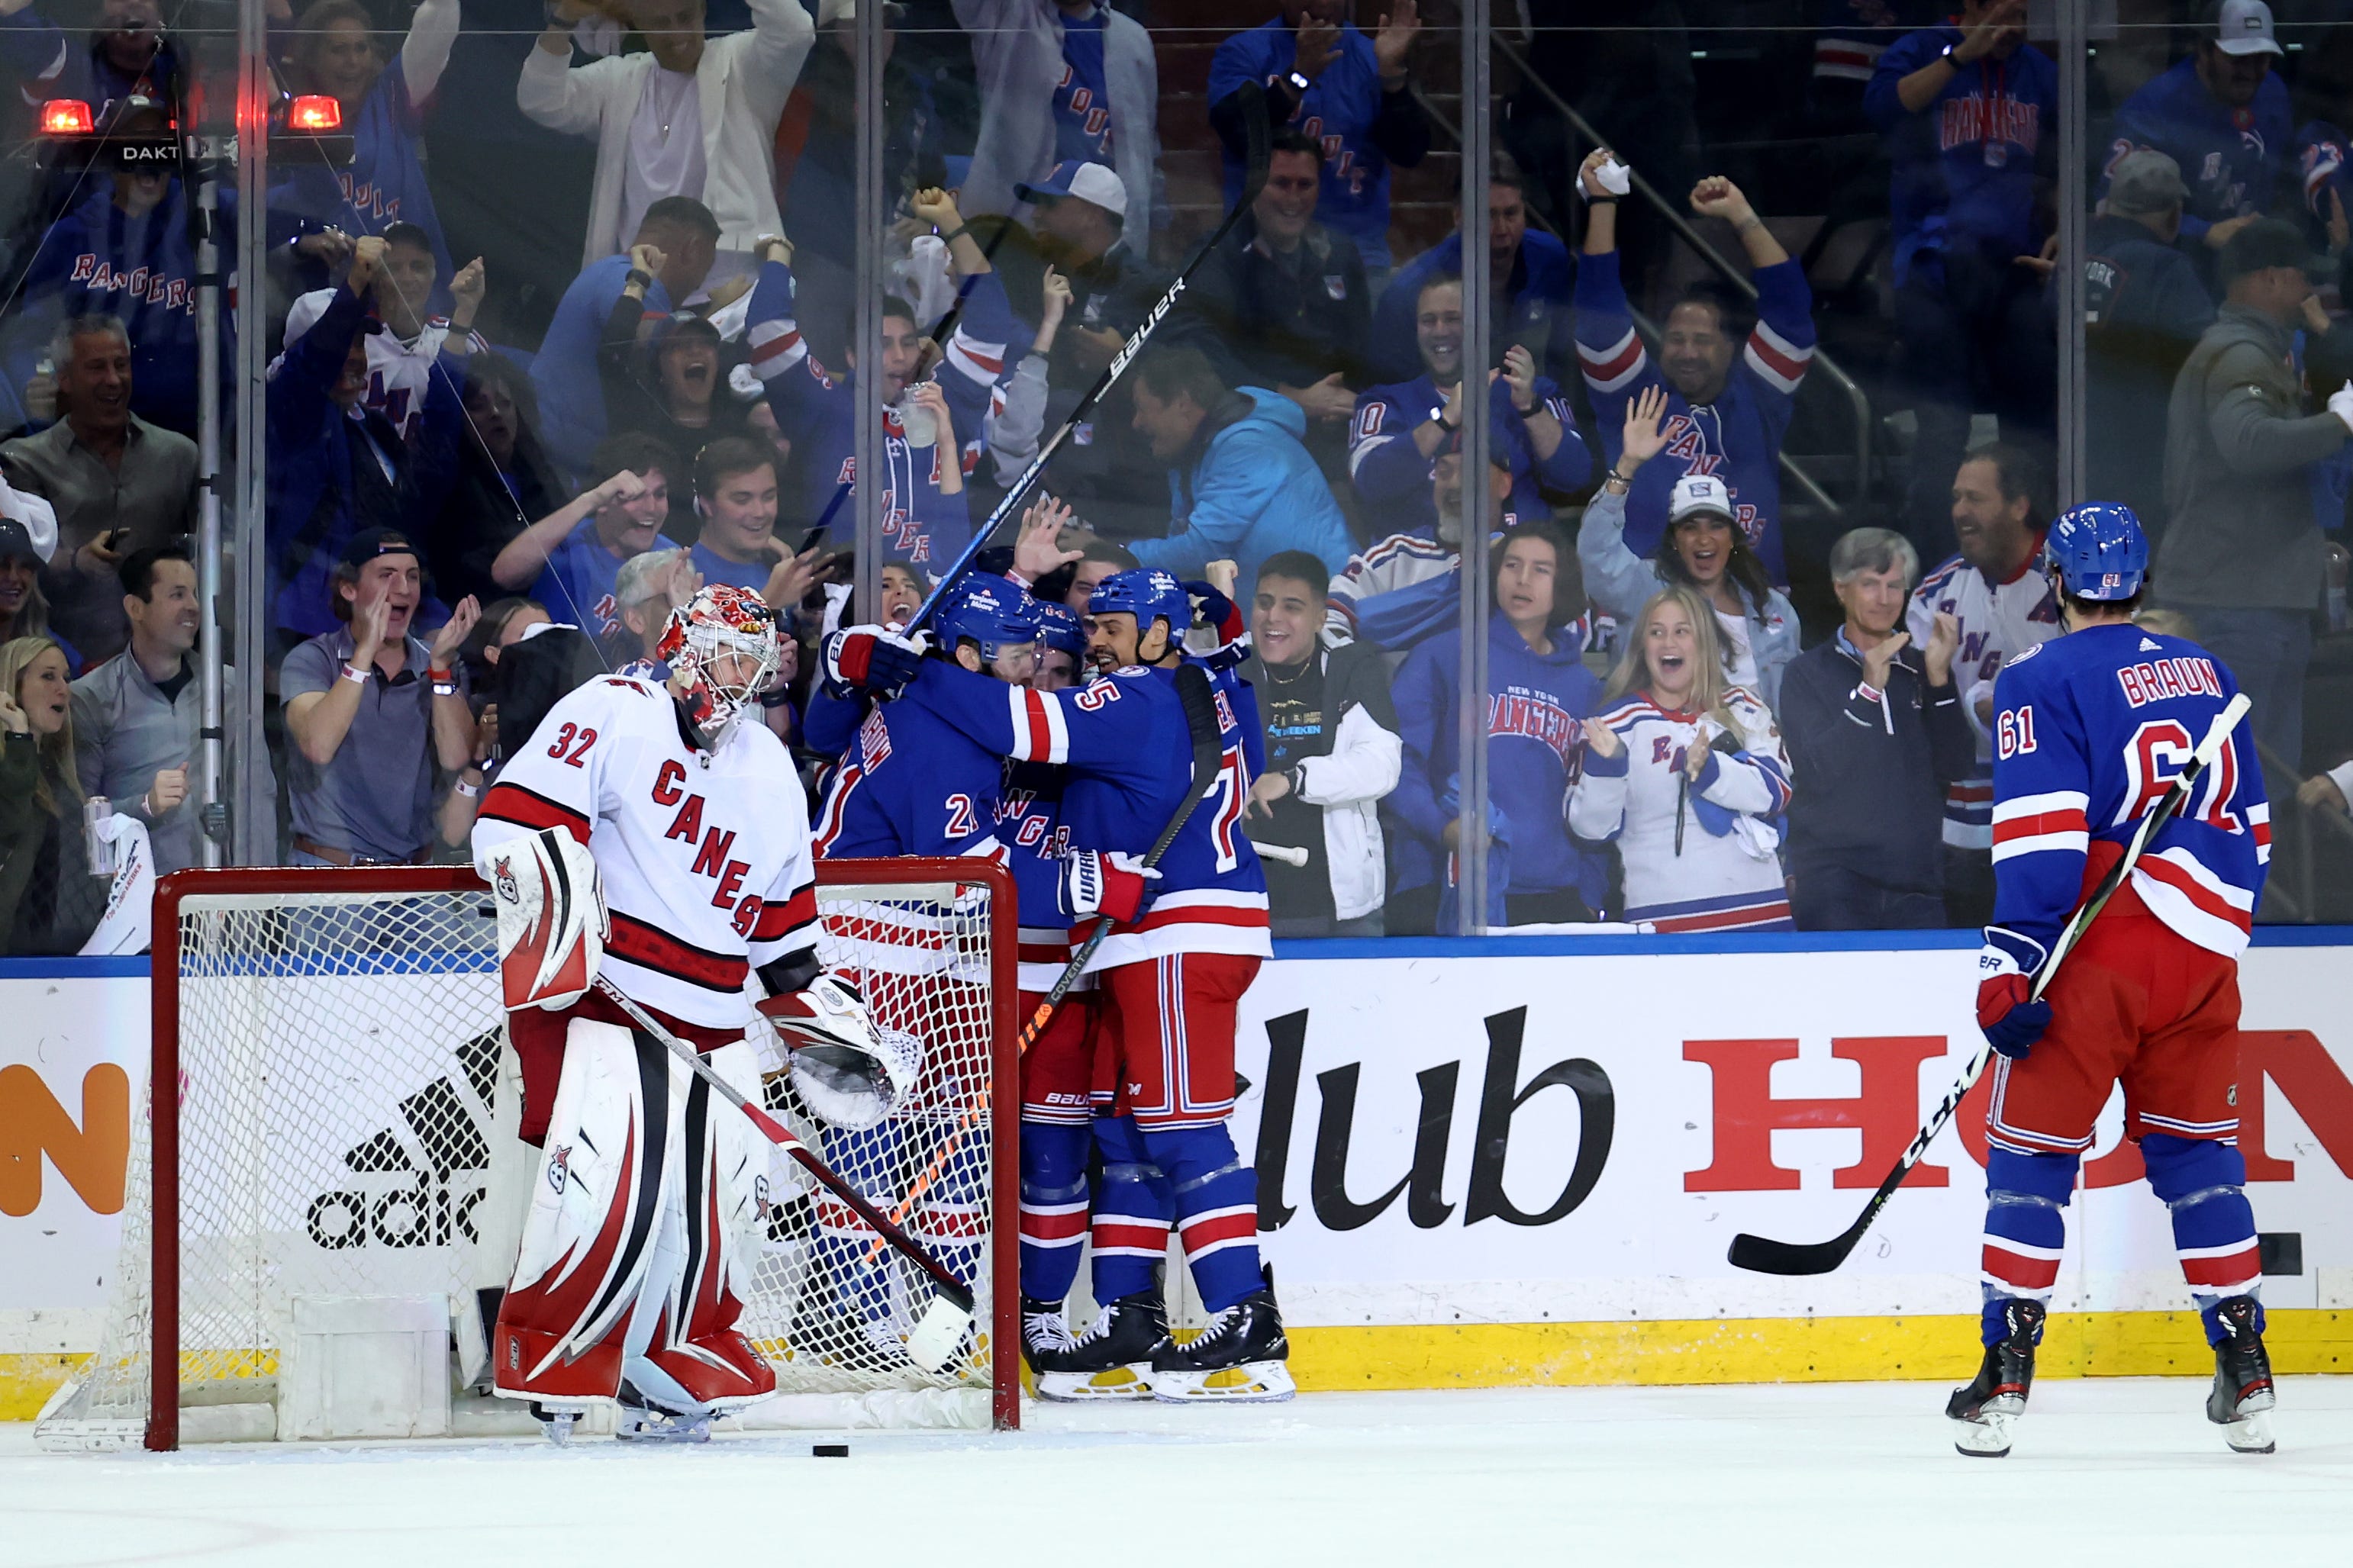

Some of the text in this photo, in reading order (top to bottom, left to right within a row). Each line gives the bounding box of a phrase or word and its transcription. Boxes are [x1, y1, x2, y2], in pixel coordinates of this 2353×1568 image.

[1109, 275, 1186, 378] BAUER
[1665, 414, 1767, 548] RANRS
[968, 592, 1001, 607] Benjamin
[2102, 572, 2121, 588] 61
[1074, 676, 1122, 713] 5
[1507, 684, 1560, 707] NEW YORK
[2116, 658, 2222, 709] BRAUN
[547, 721, 598, 769] 32
[1997, 704, 2038, 761] 61
[2111, 714, 2245, 836] 61
[652, 759, 762, 939] CANES
[1044, 1091, 1091, 1106] BAU
[1234, 1004, 1616, 1232] lub
[1901, 1071, 1972, 1168] CCM
